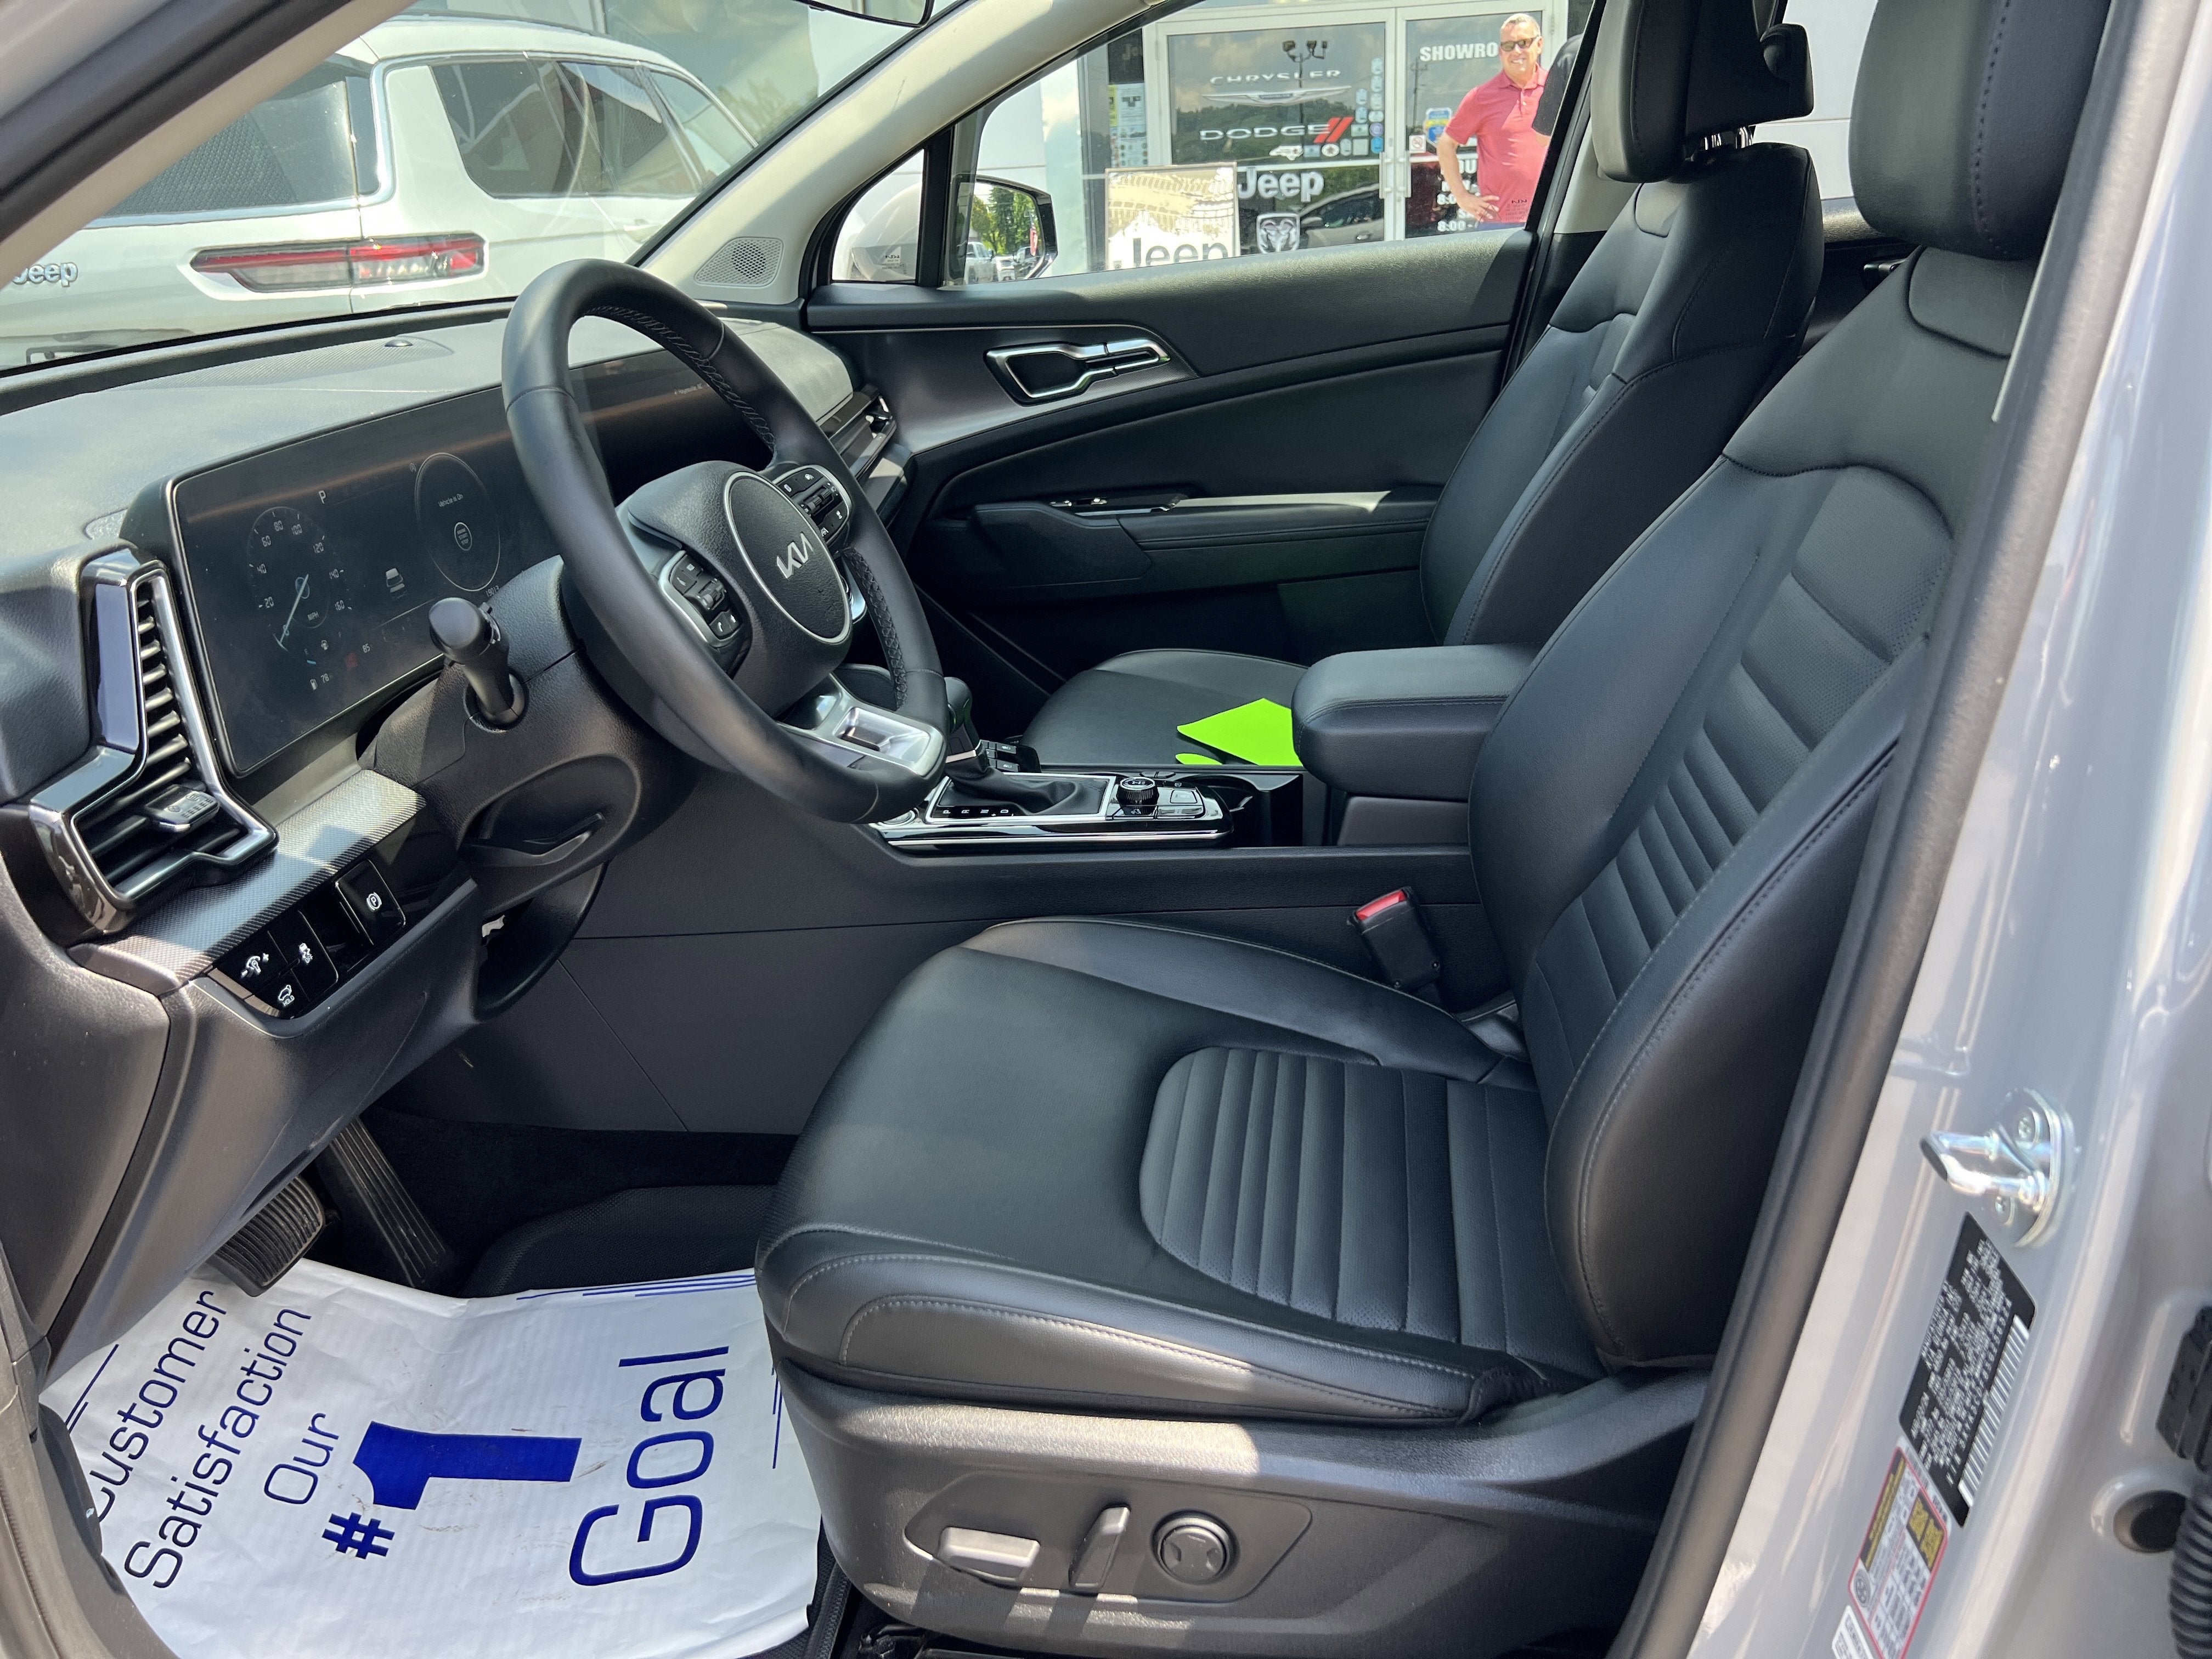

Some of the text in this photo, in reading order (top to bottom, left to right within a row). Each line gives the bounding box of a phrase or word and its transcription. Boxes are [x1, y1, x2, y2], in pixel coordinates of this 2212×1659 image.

[1419, 42, 1498, 61] SHOWRO
[1210, 70, 1341, 84] CHRYSLER
[1199, 123, 1331, 140] DODGE
[1238, 166, 1324, 202] Jeep
[318, 490, 326, 504] P
[274, 520, 284, 531] 80
[291, 524, 302, 535] 100
[261, 535, 272, 547] 60
[313, 542, 324, 554] 120
[257, 563, 267, 574] 40
[329, 568, 340, 579] 140
[264, 596, 274, 608] 20
[335, 600, 345, 611] 160
[124, 1308, 312, 1588] Satisfaction
[264, 1412, 341, 1505] Our
[569, 1346, 729, 1587] Goal
